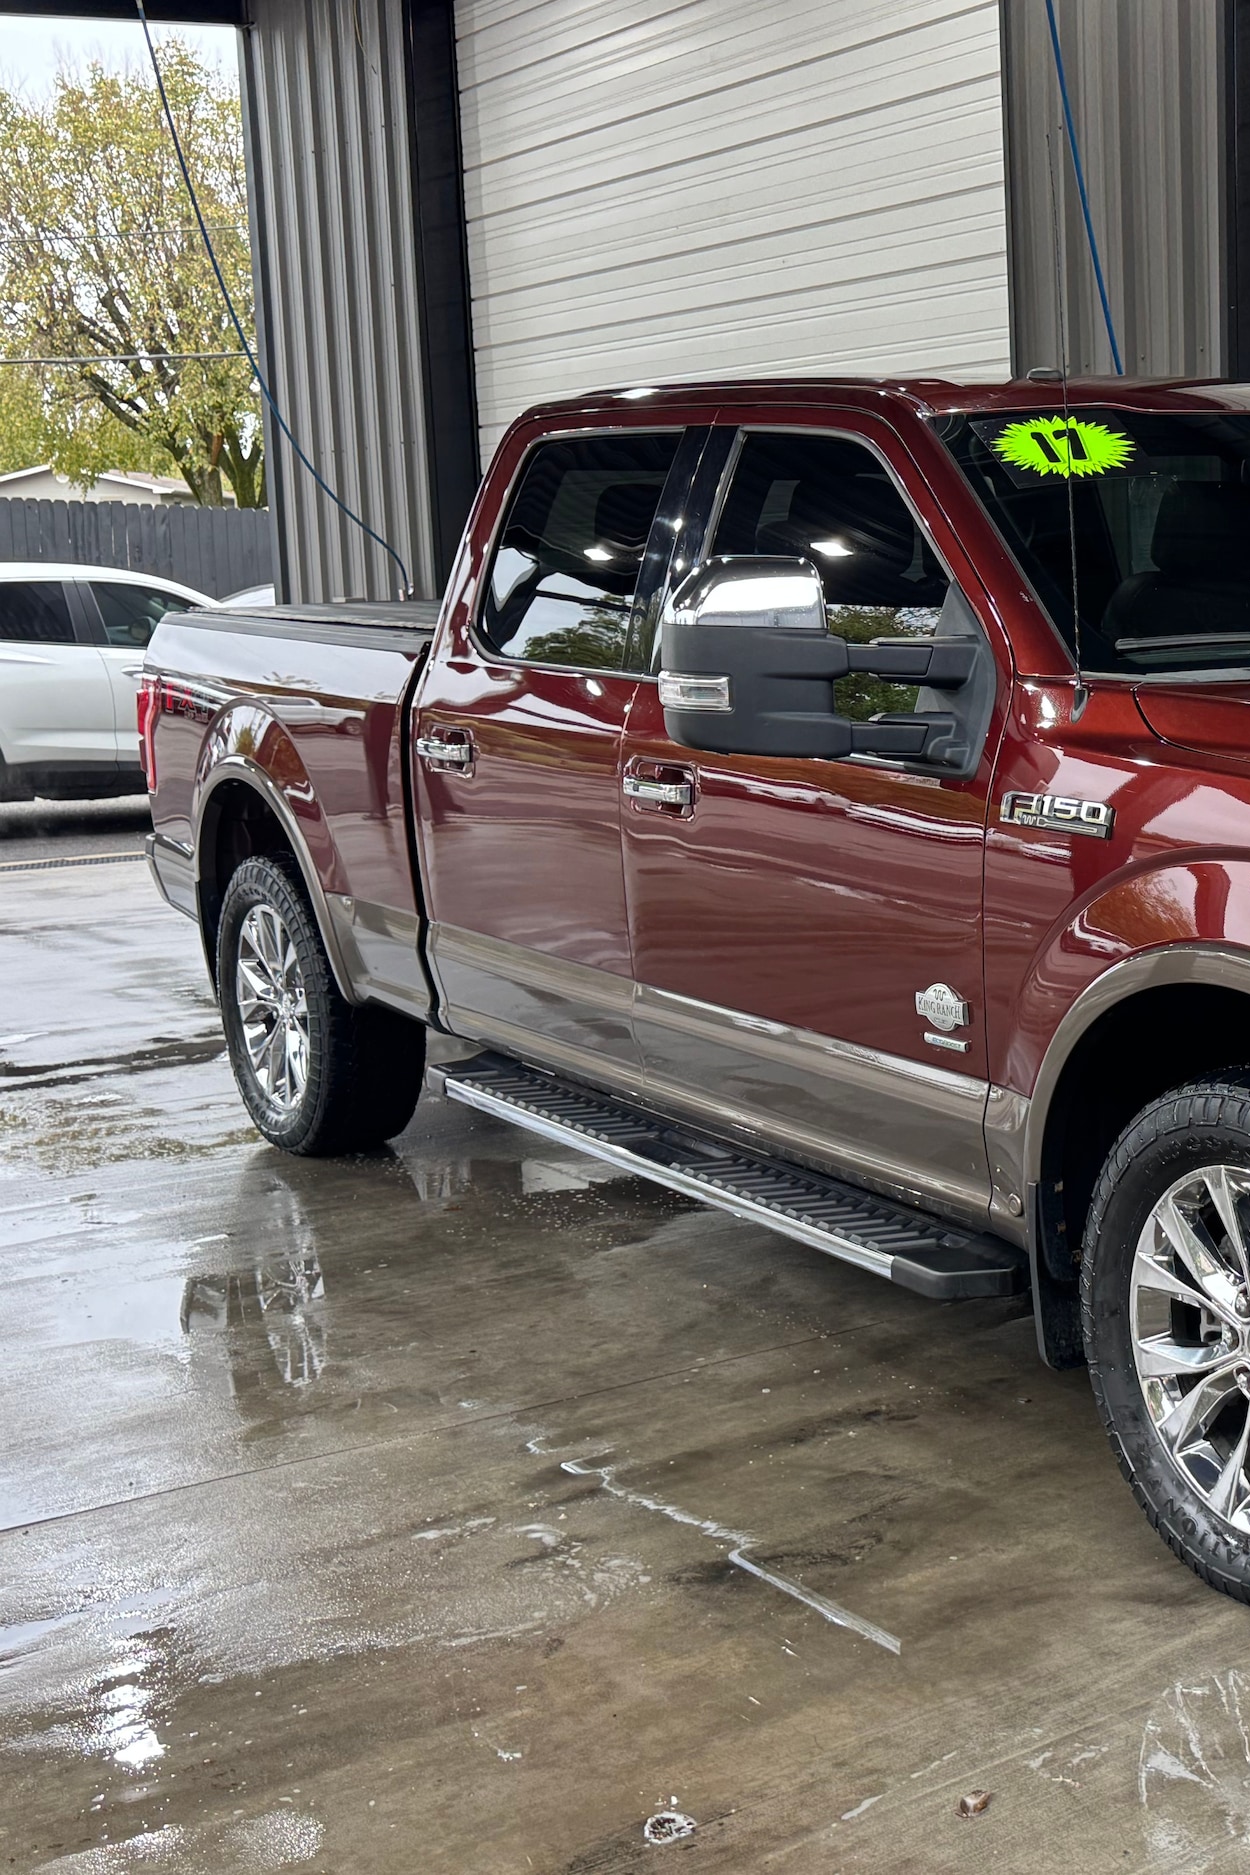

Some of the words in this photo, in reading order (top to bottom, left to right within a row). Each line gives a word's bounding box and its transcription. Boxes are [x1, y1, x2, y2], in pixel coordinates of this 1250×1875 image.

[1030, 427, 1091, 464] 17
[918, 996, 936, 1014] KING
[936, 1003, 961, 1020] RANCH
